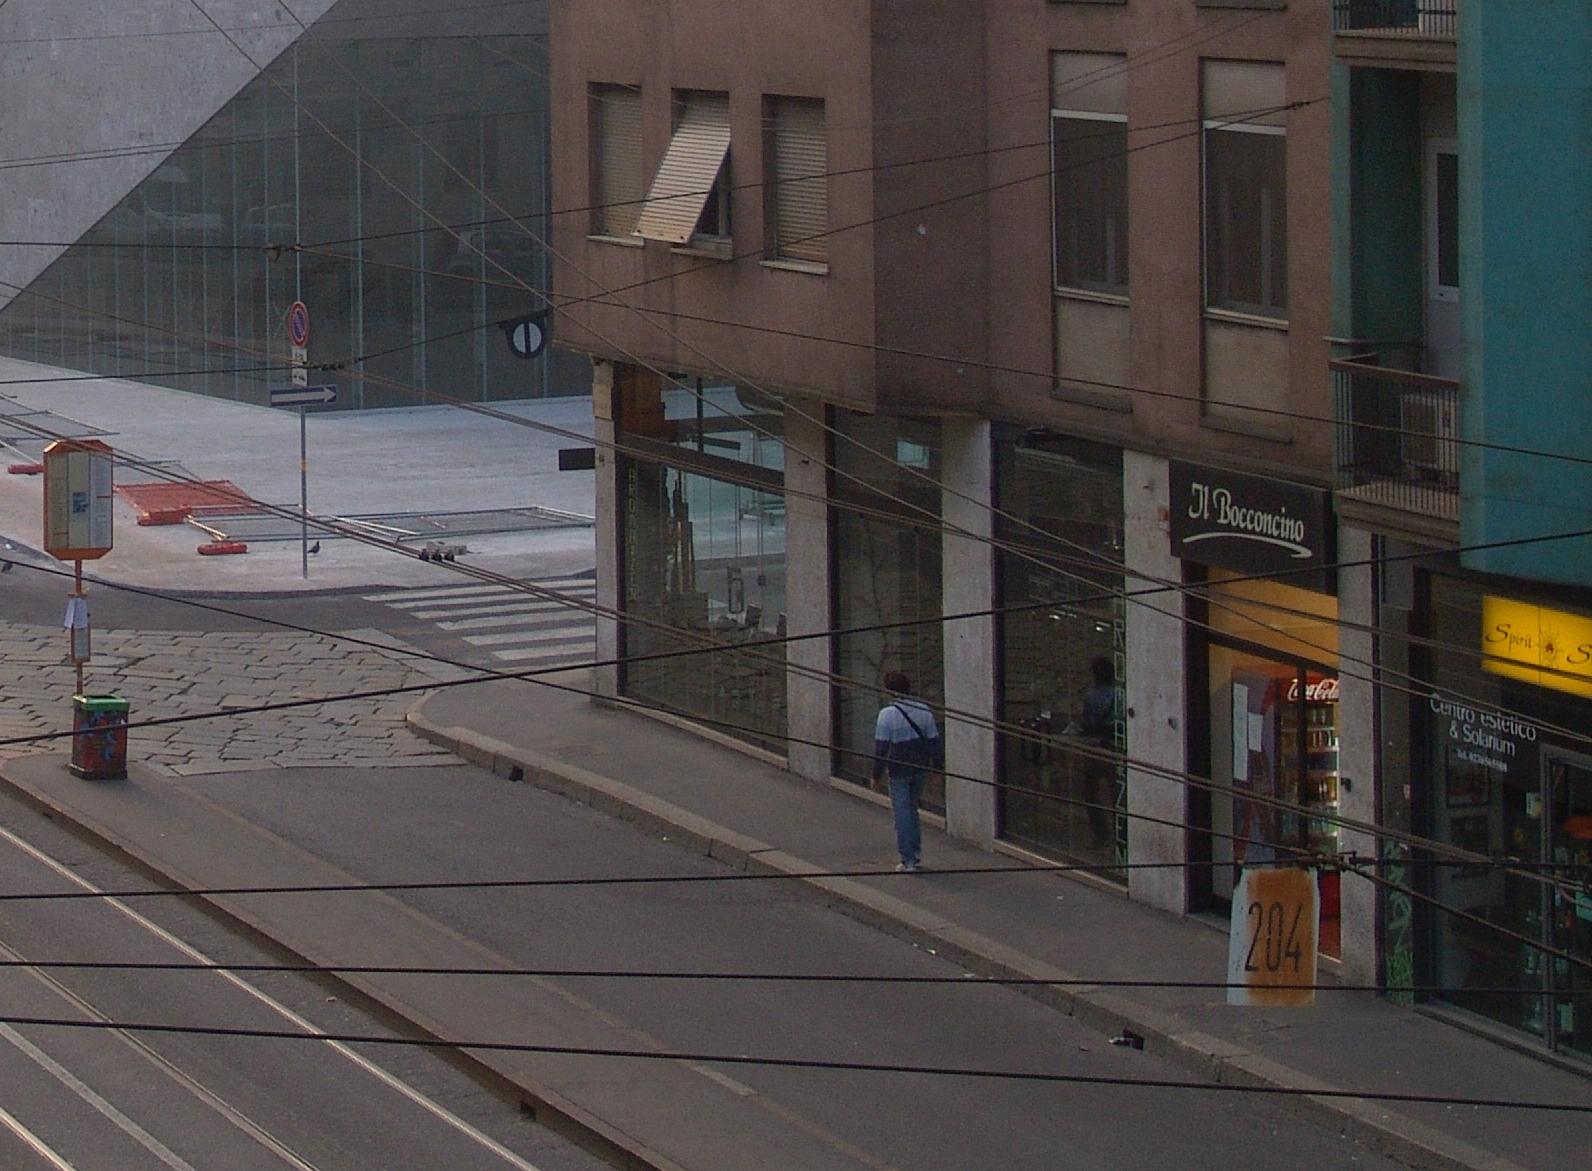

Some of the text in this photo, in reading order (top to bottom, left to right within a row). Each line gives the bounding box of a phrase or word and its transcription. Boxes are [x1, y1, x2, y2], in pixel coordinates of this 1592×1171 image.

[1212, 488, 1304, 542] Bocconcino
[1485, 623, 1532, 653] Spirit
[1430, 693, 1537, 741] Centro estetico
[1449, 720, 1516, 757] & Solarium
[1244, 900, 1303, 973] 204
